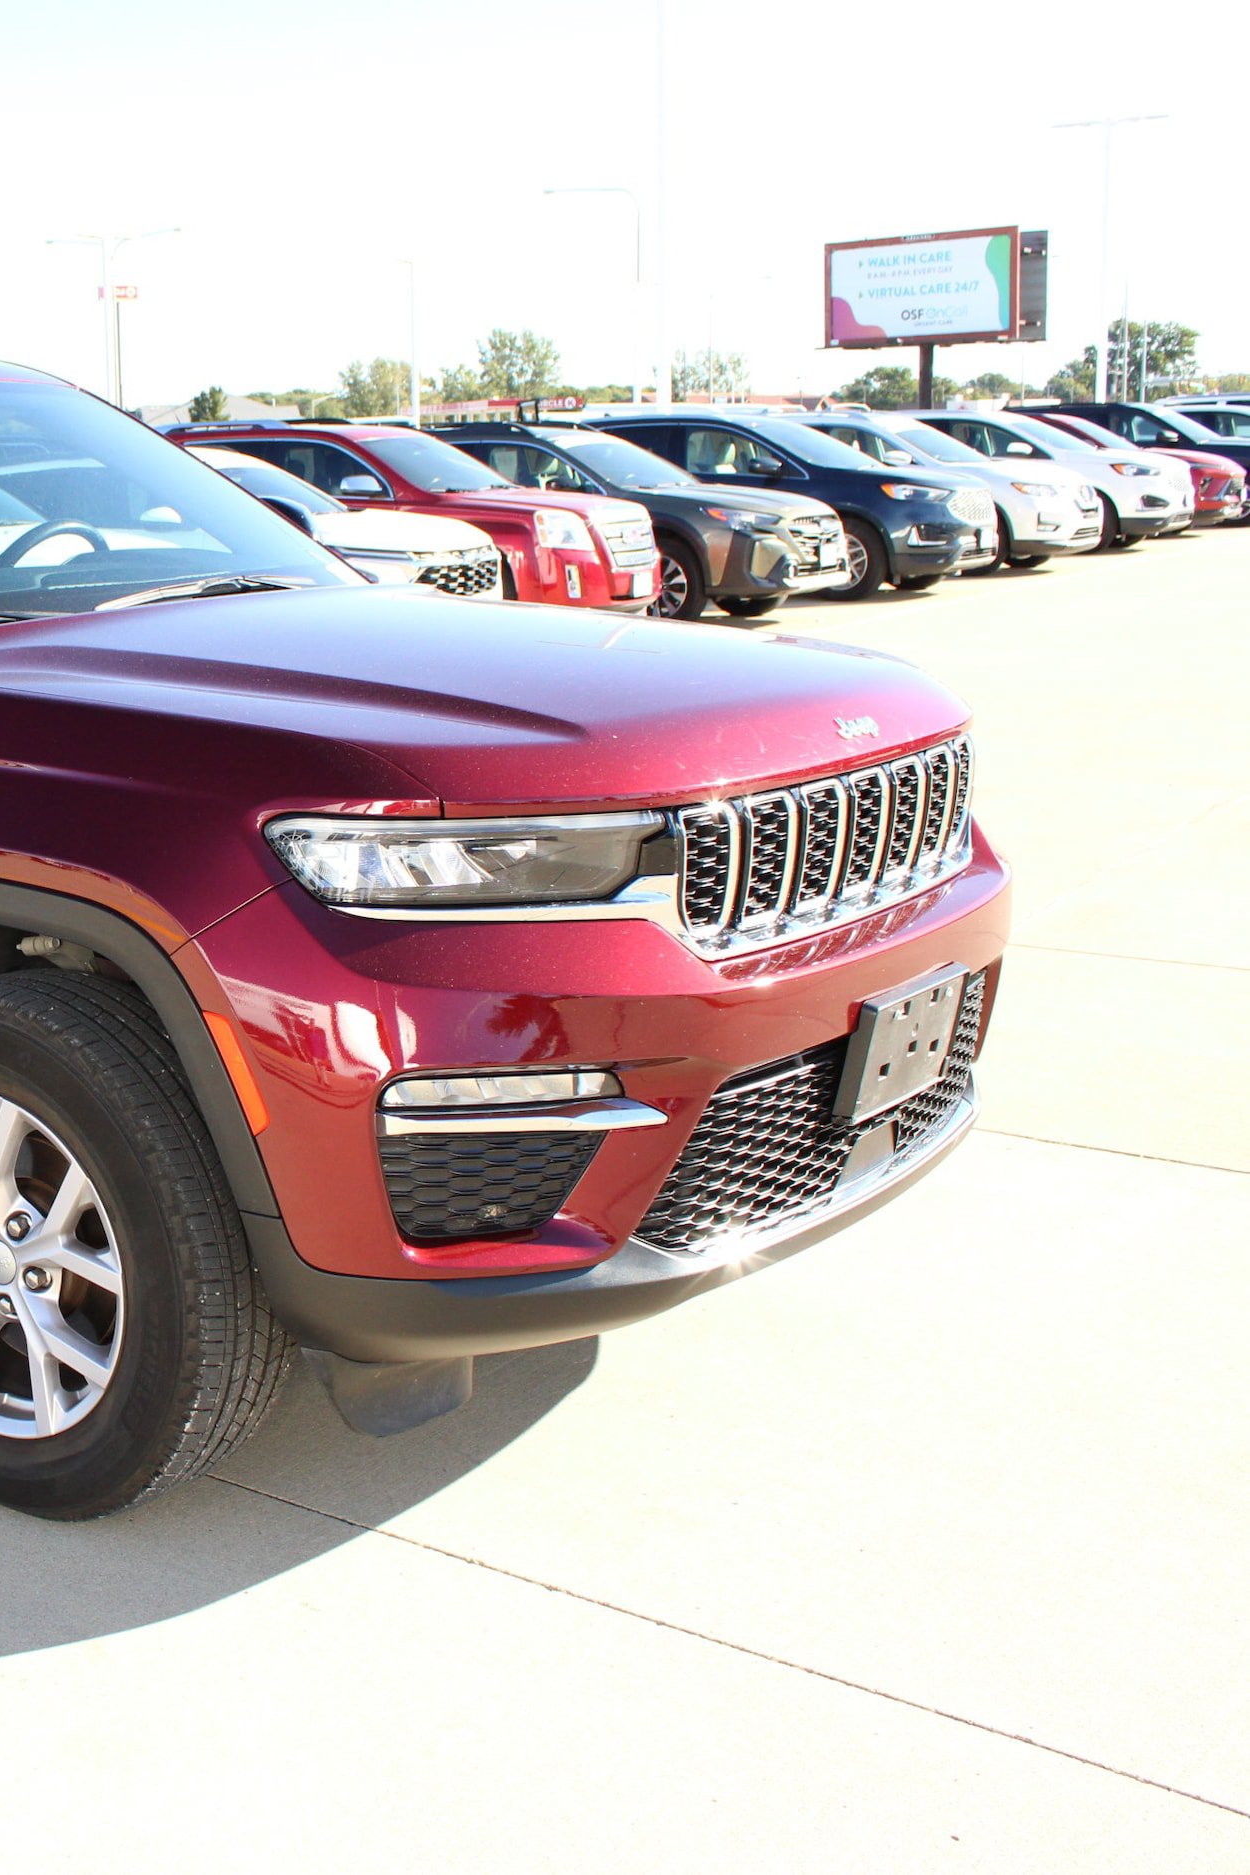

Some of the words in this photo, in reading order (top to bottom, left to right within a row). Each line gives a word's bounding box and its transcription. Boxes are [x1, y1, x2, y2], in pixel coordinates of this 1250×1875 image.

[868, 256, 899, 267] WALK
[903, 253, 916, 265] IN
[919, 251, 951, 263] CARE
[868, 285, 916, 299] VIRTUAL
[919, 282, 951, 295] CARE
[955, 280, 979, 293] 24/7
[901, 308, 924, 321] OSF
[833, 716, 879, 740] Jeep
